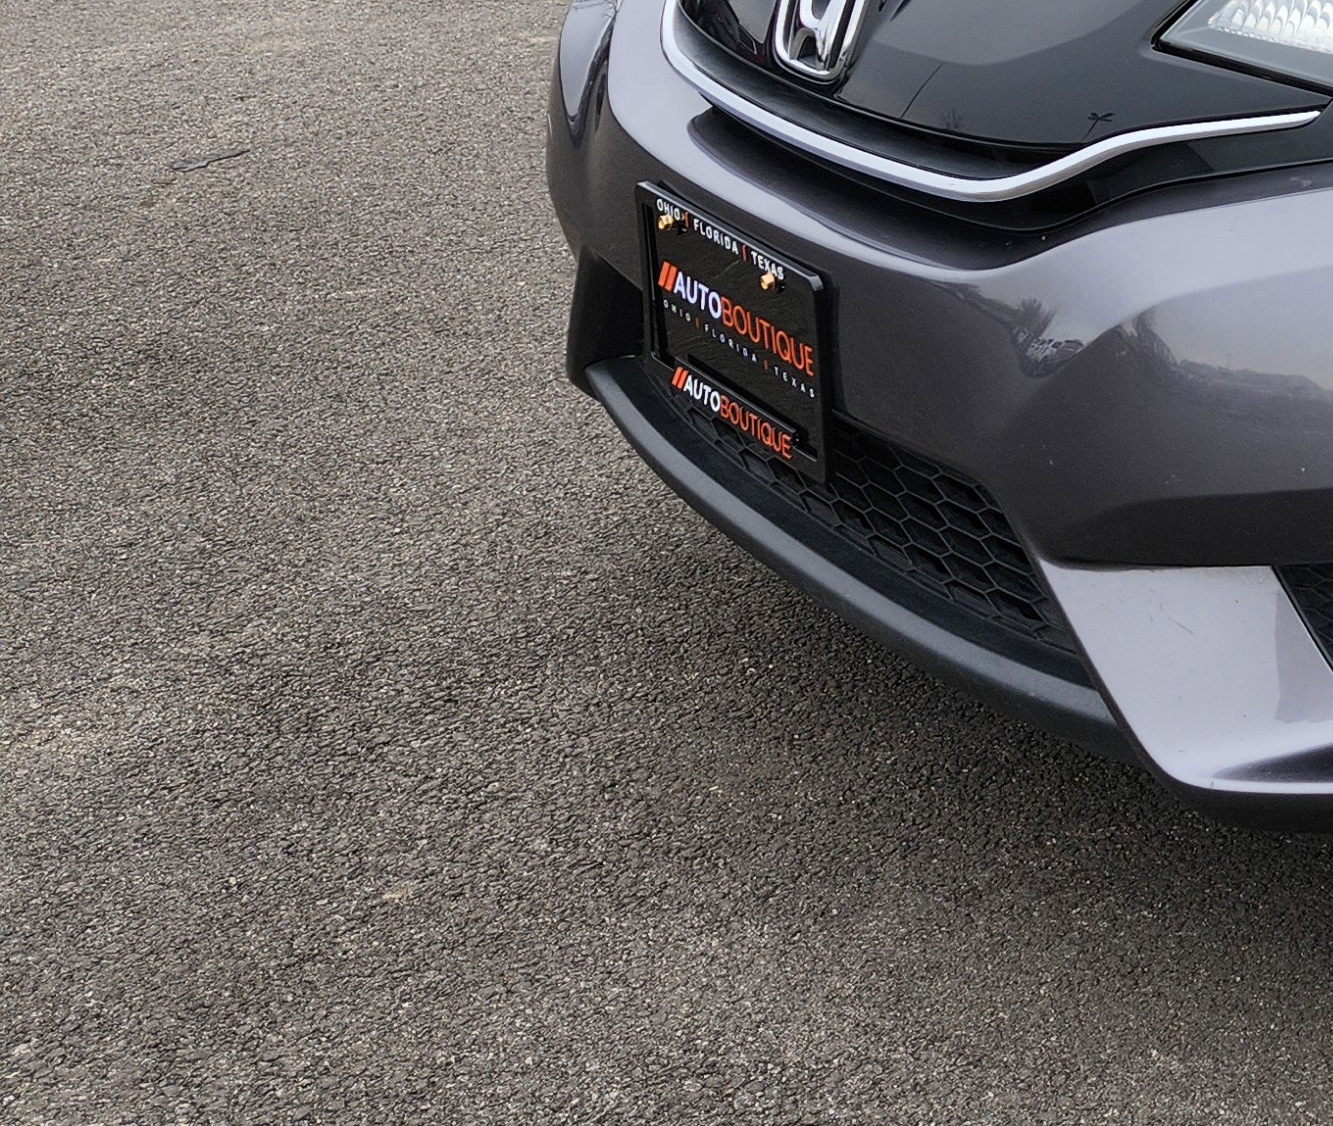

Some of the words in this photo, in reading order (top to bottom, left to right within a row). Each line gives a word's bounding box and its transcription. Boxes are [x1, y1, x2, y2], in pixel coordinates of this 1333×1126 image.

[656, 198, 681, 221] OHIO
[693, 218, 739, 255] FLORIDA
[751, 250, 785, 280] TEXAS
[663, 299, 691, 322] OHIO
[704, 324, 757, 362] FLORIDA
[773, 366, 815, 398] TEXAS
